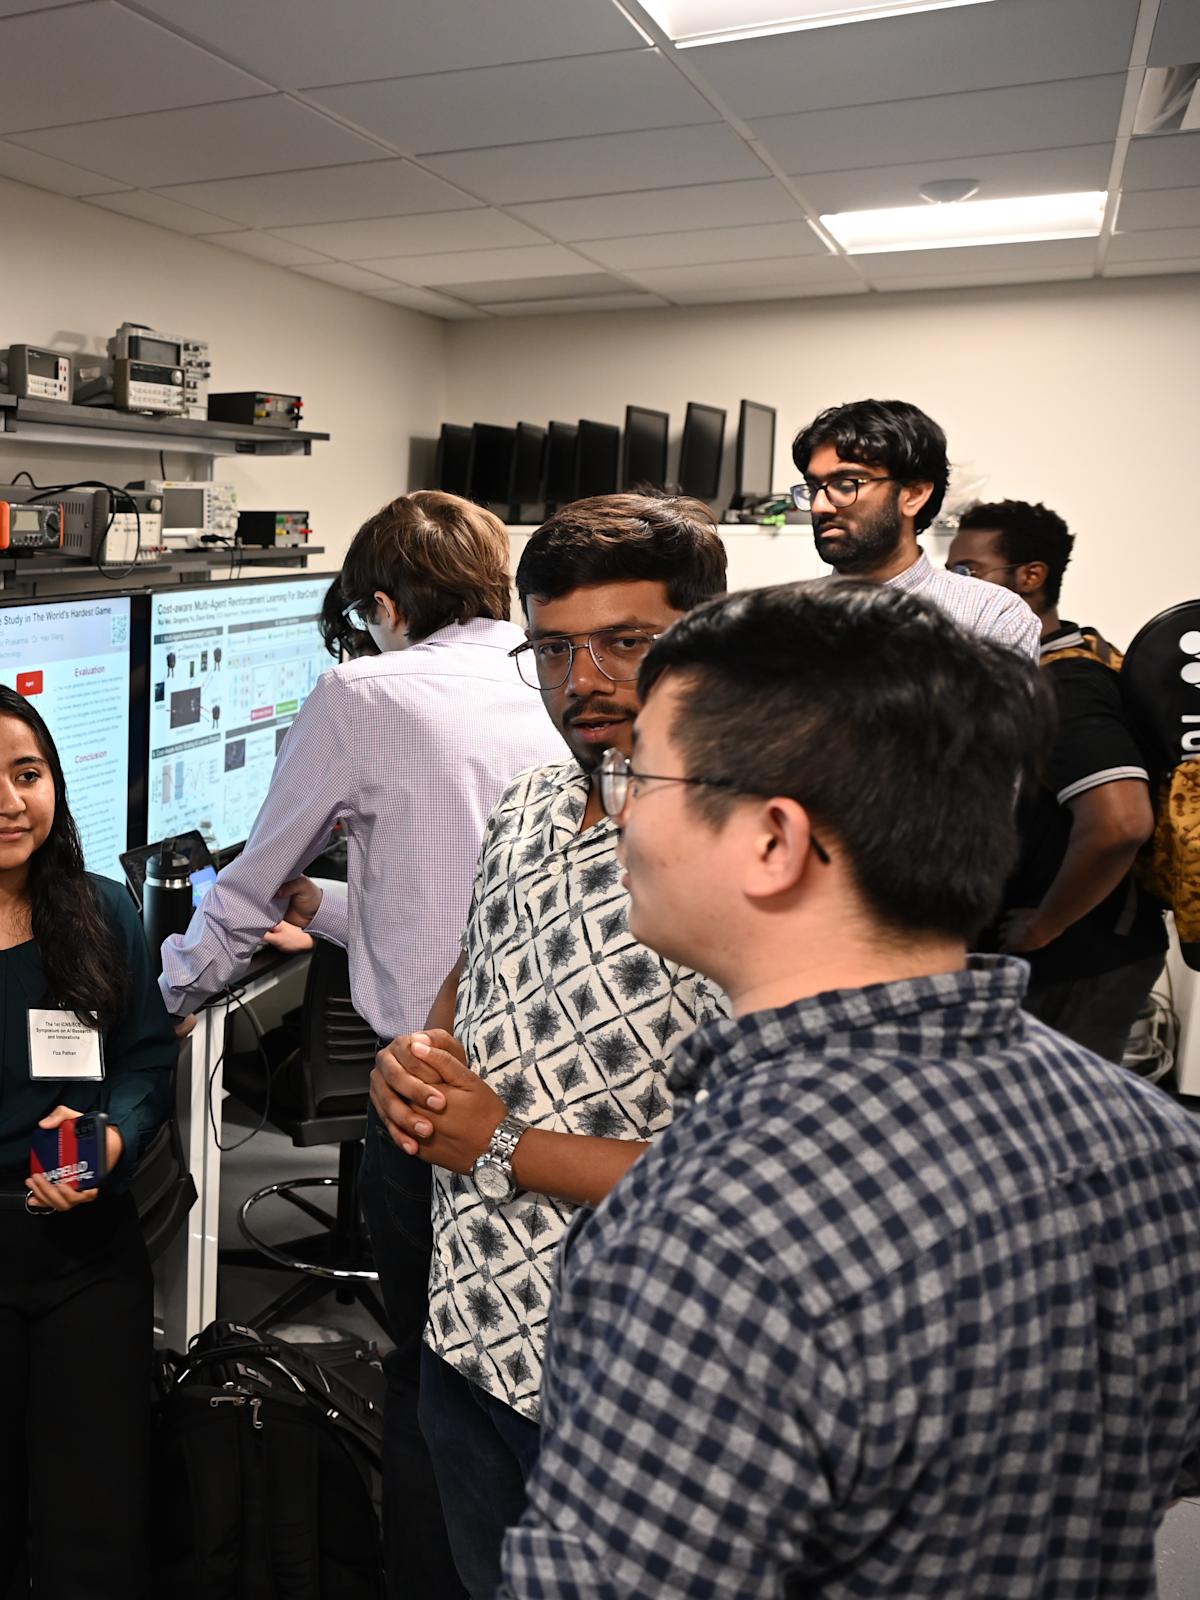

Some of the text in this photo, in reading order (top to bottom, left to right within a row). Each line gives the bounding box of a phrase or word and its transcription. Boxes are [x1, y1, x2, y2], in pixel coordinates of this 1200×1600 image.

[4, 616, 22, 627] Study
[32, 612, 44, 622] The
[46, 609, 69, 620] World's
[70, 607, 94, 618] Hardest
[95, 606, 112, 616] Game
[74, 666, 105, 677] Evaluation
[74, 750, 107, 764] Conclusion
